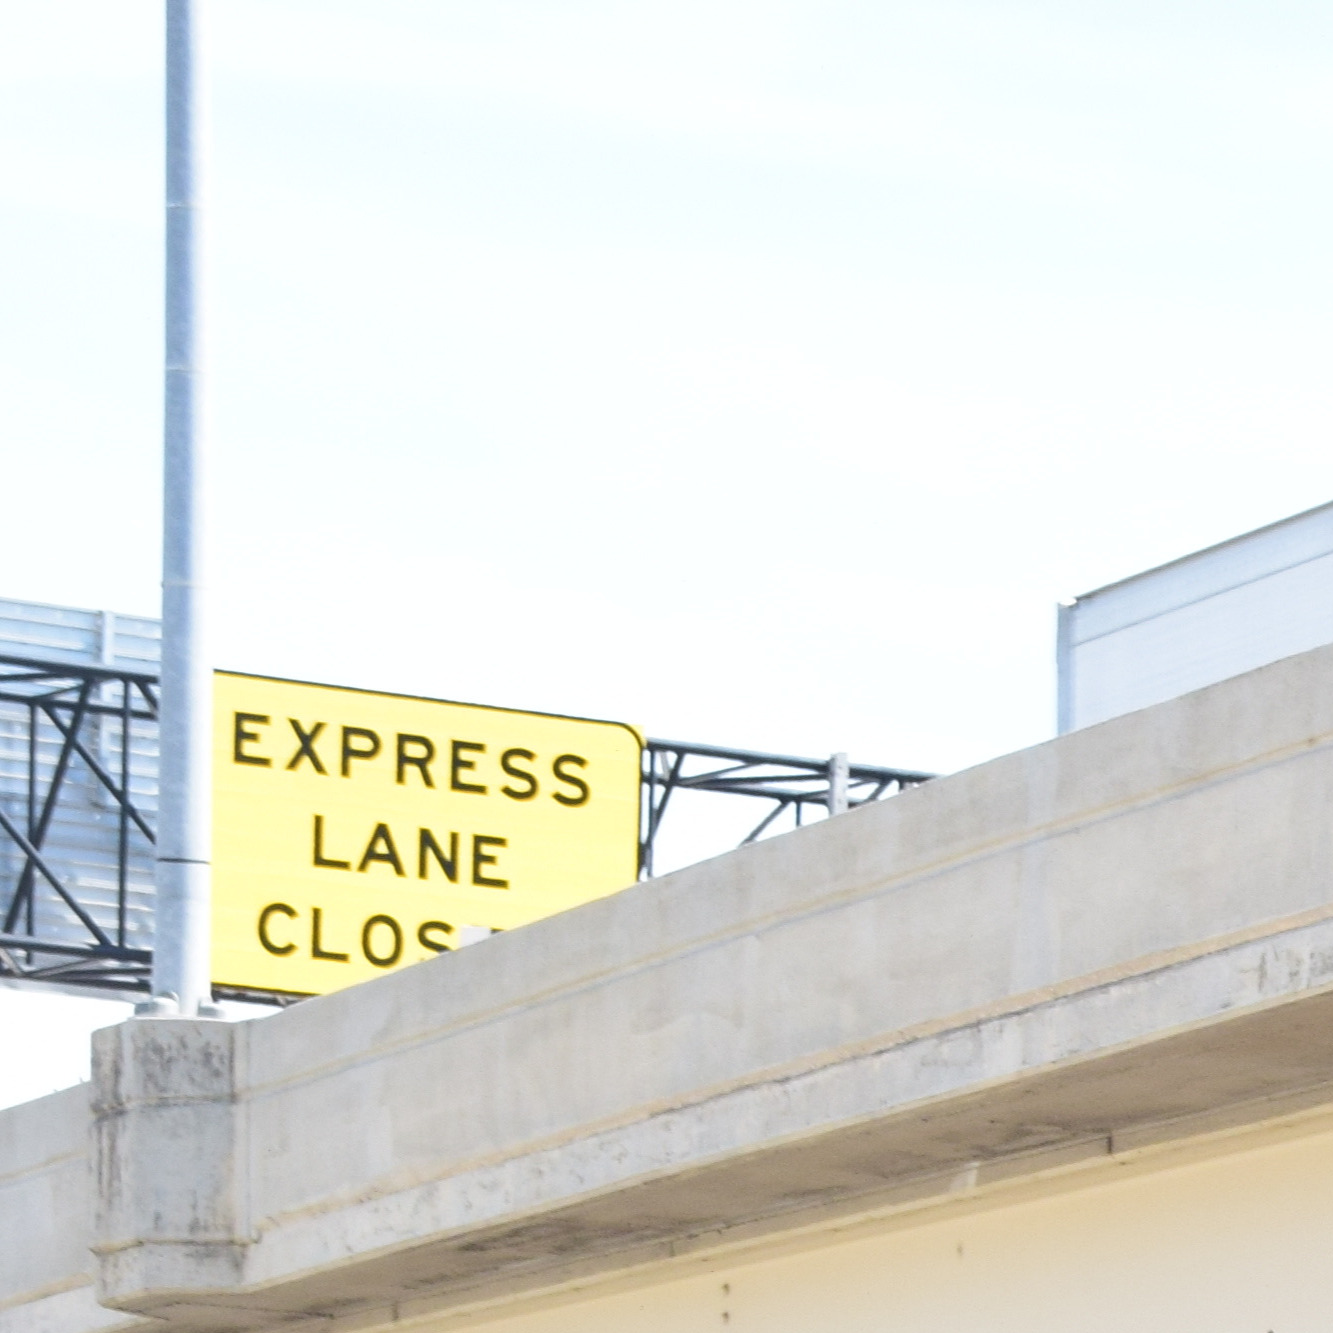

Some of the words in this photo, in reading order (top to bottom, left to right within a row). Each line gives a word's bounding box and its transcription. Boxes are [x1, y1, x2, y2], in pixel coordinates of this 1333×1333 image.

[233, 711, 591, 807] EXPRESS
[312, 814, 509, 890] LANE
[257, 902, 504, 968] CLOS
